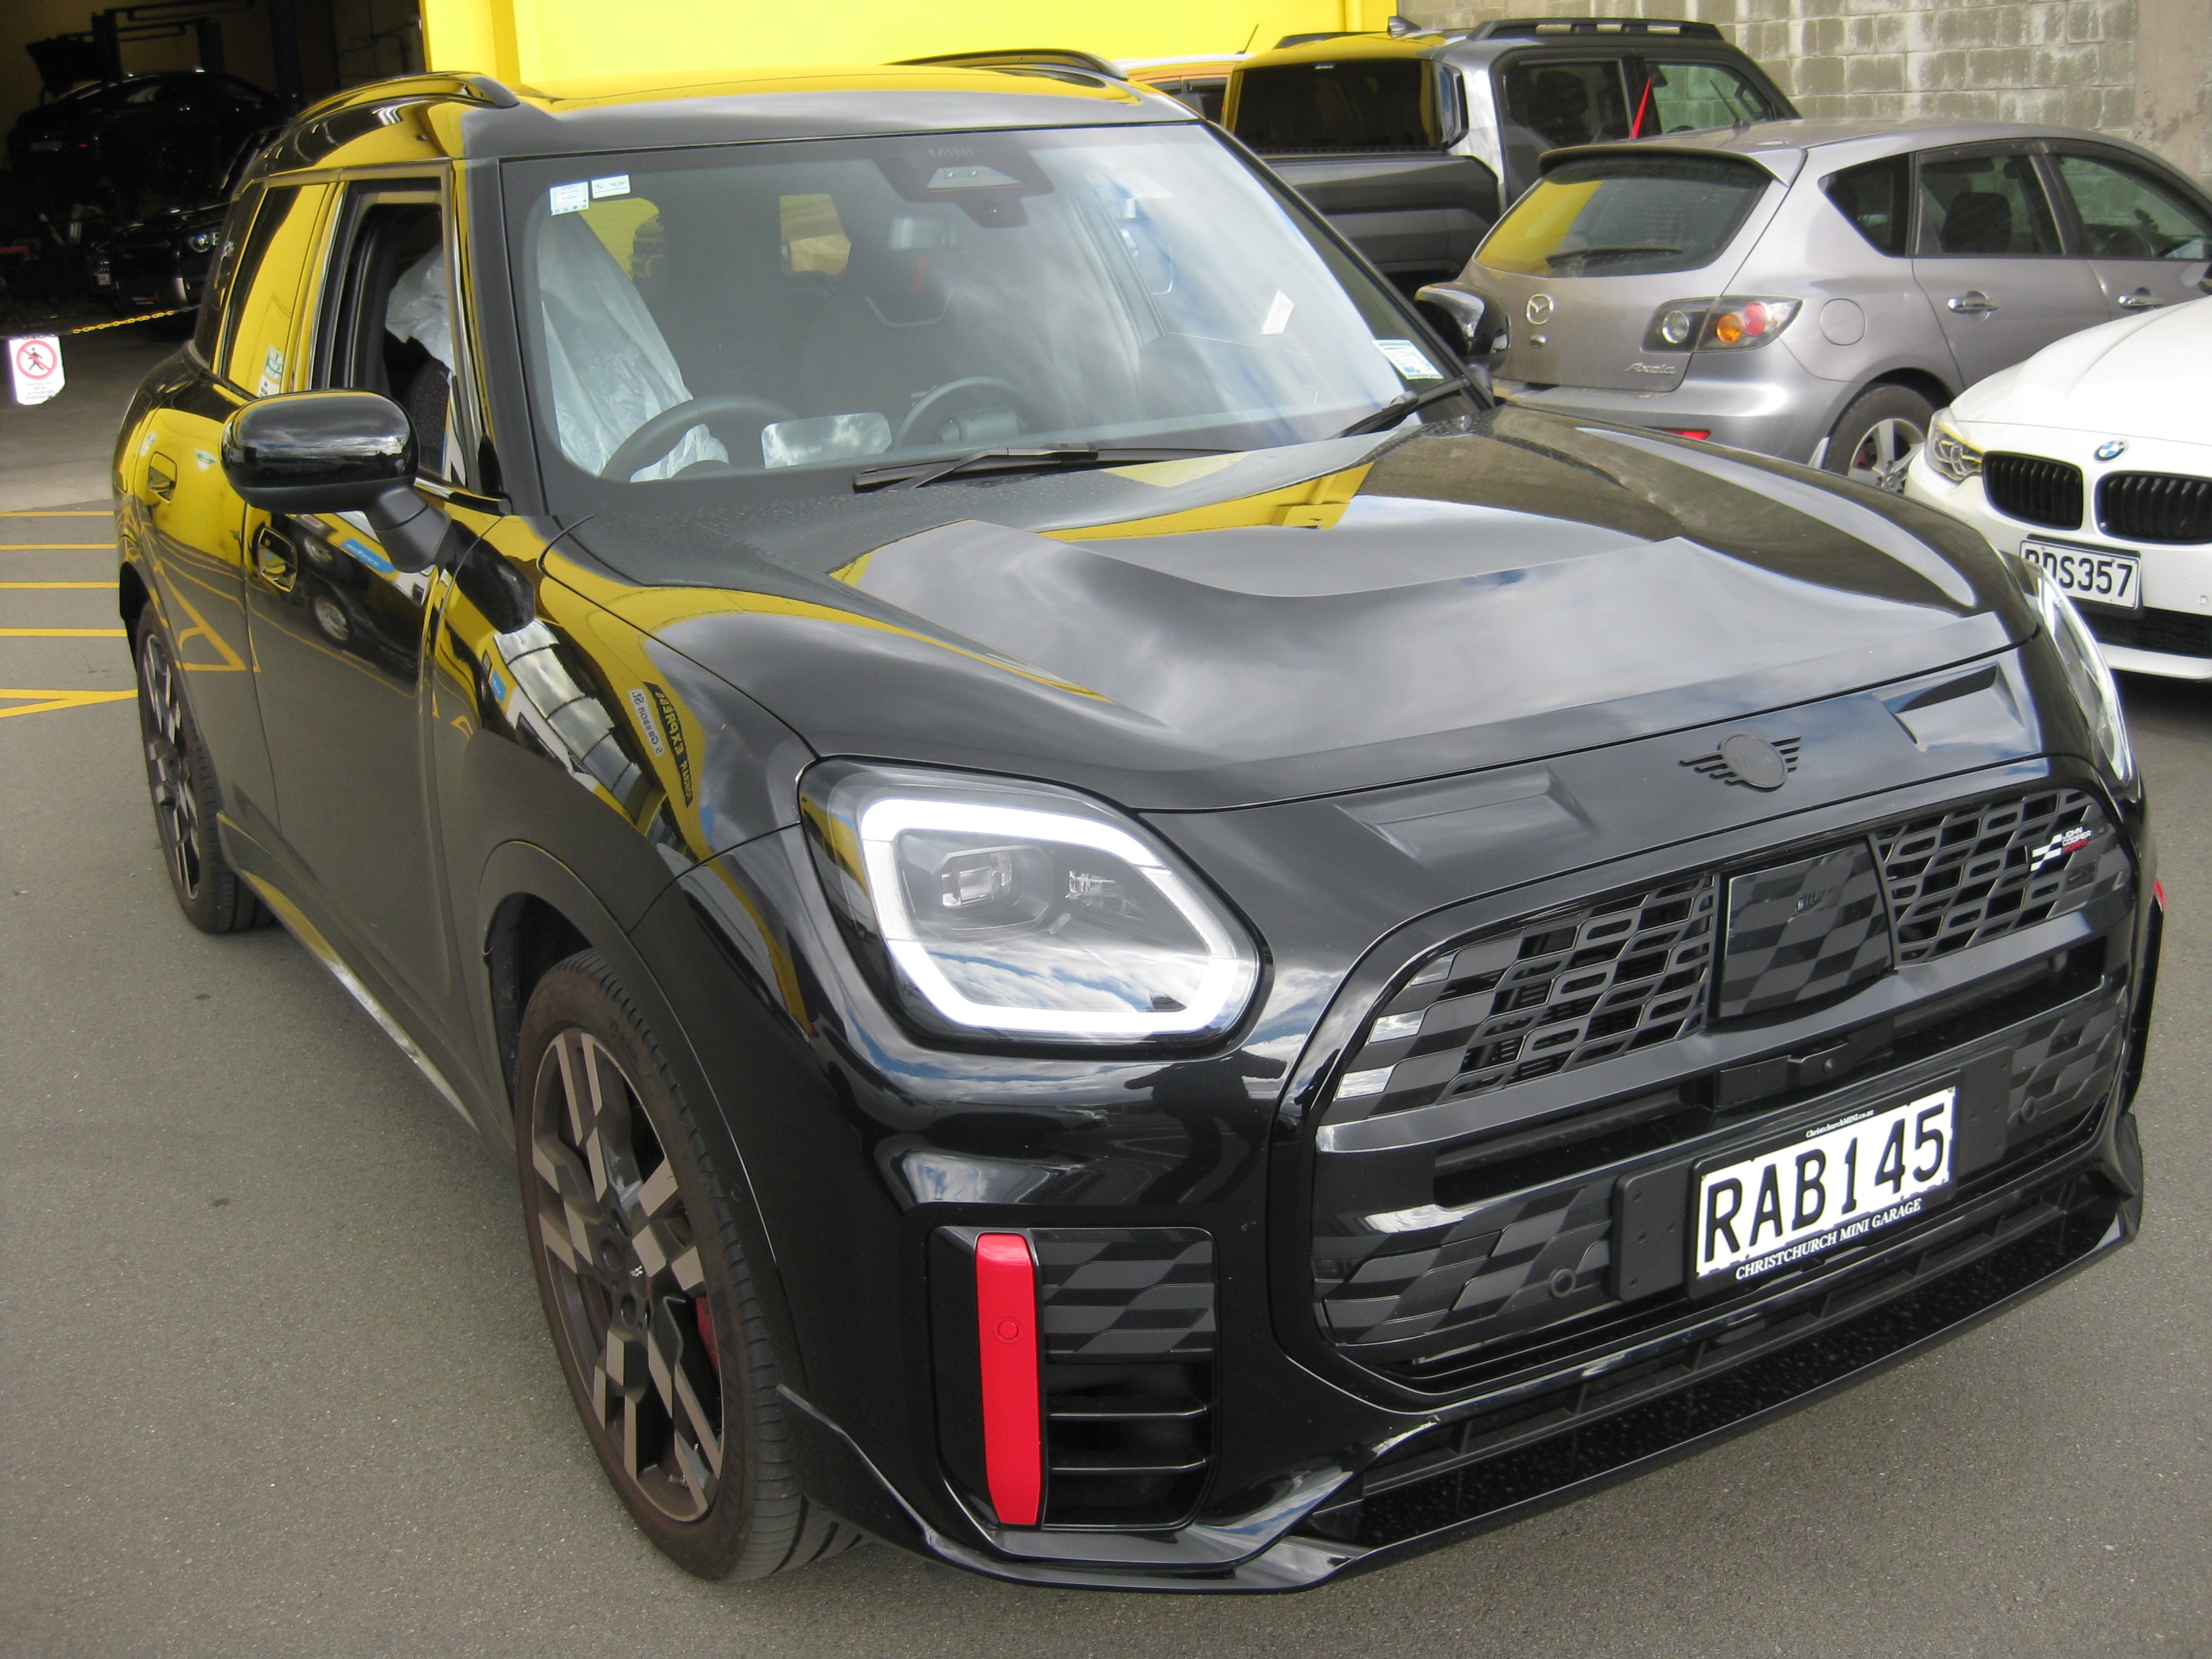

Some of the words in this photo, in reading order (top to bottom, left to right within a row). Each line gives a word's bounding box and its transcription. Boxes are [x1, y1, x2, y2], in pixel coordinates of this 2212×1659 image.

[2062, 830, 2091, 846] COOPER
[1704, 1103, 1944, 1263] RAB145
[1735, 1230, 1839, 1281] CHRISTCHURCH
[1839, 1218, 1870, 1242] MINI
[1871, 1197, 1922, 1228] GARAGE
